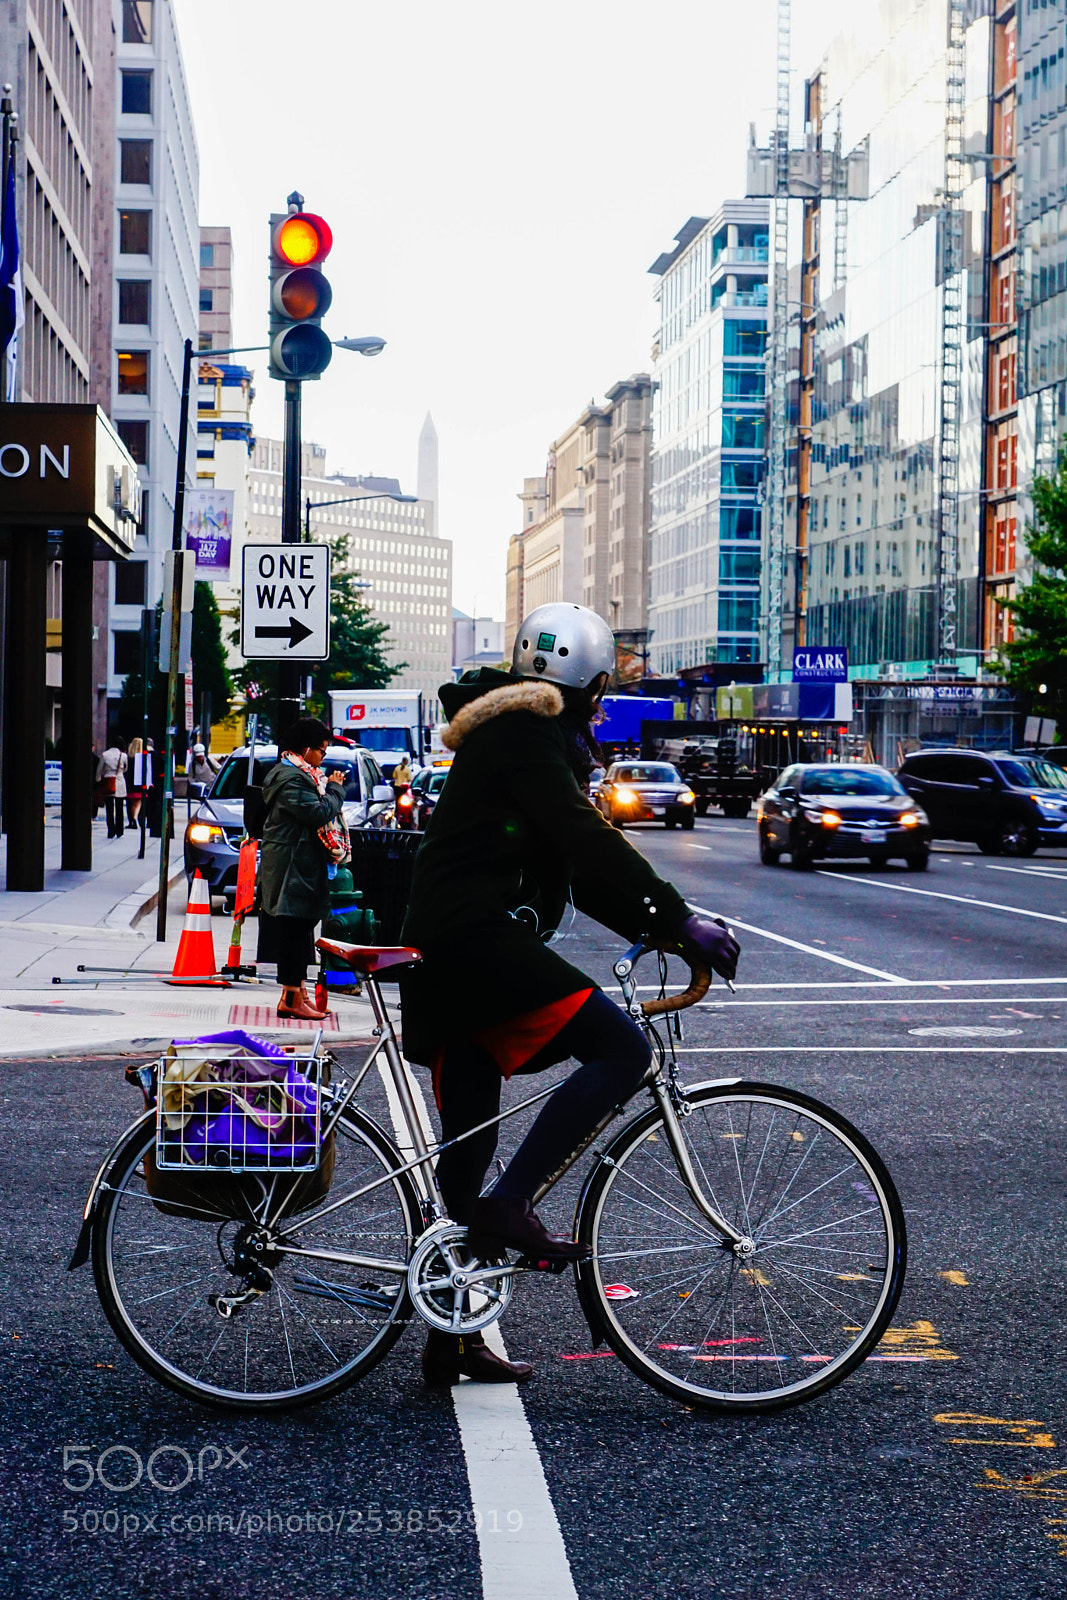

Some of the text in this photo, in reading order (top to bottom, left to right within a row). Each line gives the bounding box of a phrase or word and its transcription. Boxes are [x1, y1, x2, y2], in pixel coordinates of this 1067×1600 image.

[0, 443, 70, 479] ON
[199, 543, 217, 552] JAZZ
[258, 553, 314, 579] ONE
[256, 585, 316, 609] WAY
[795, 653, 845, 669] CLARK
[795, 669, 845, 677] CONSTRUCTION
